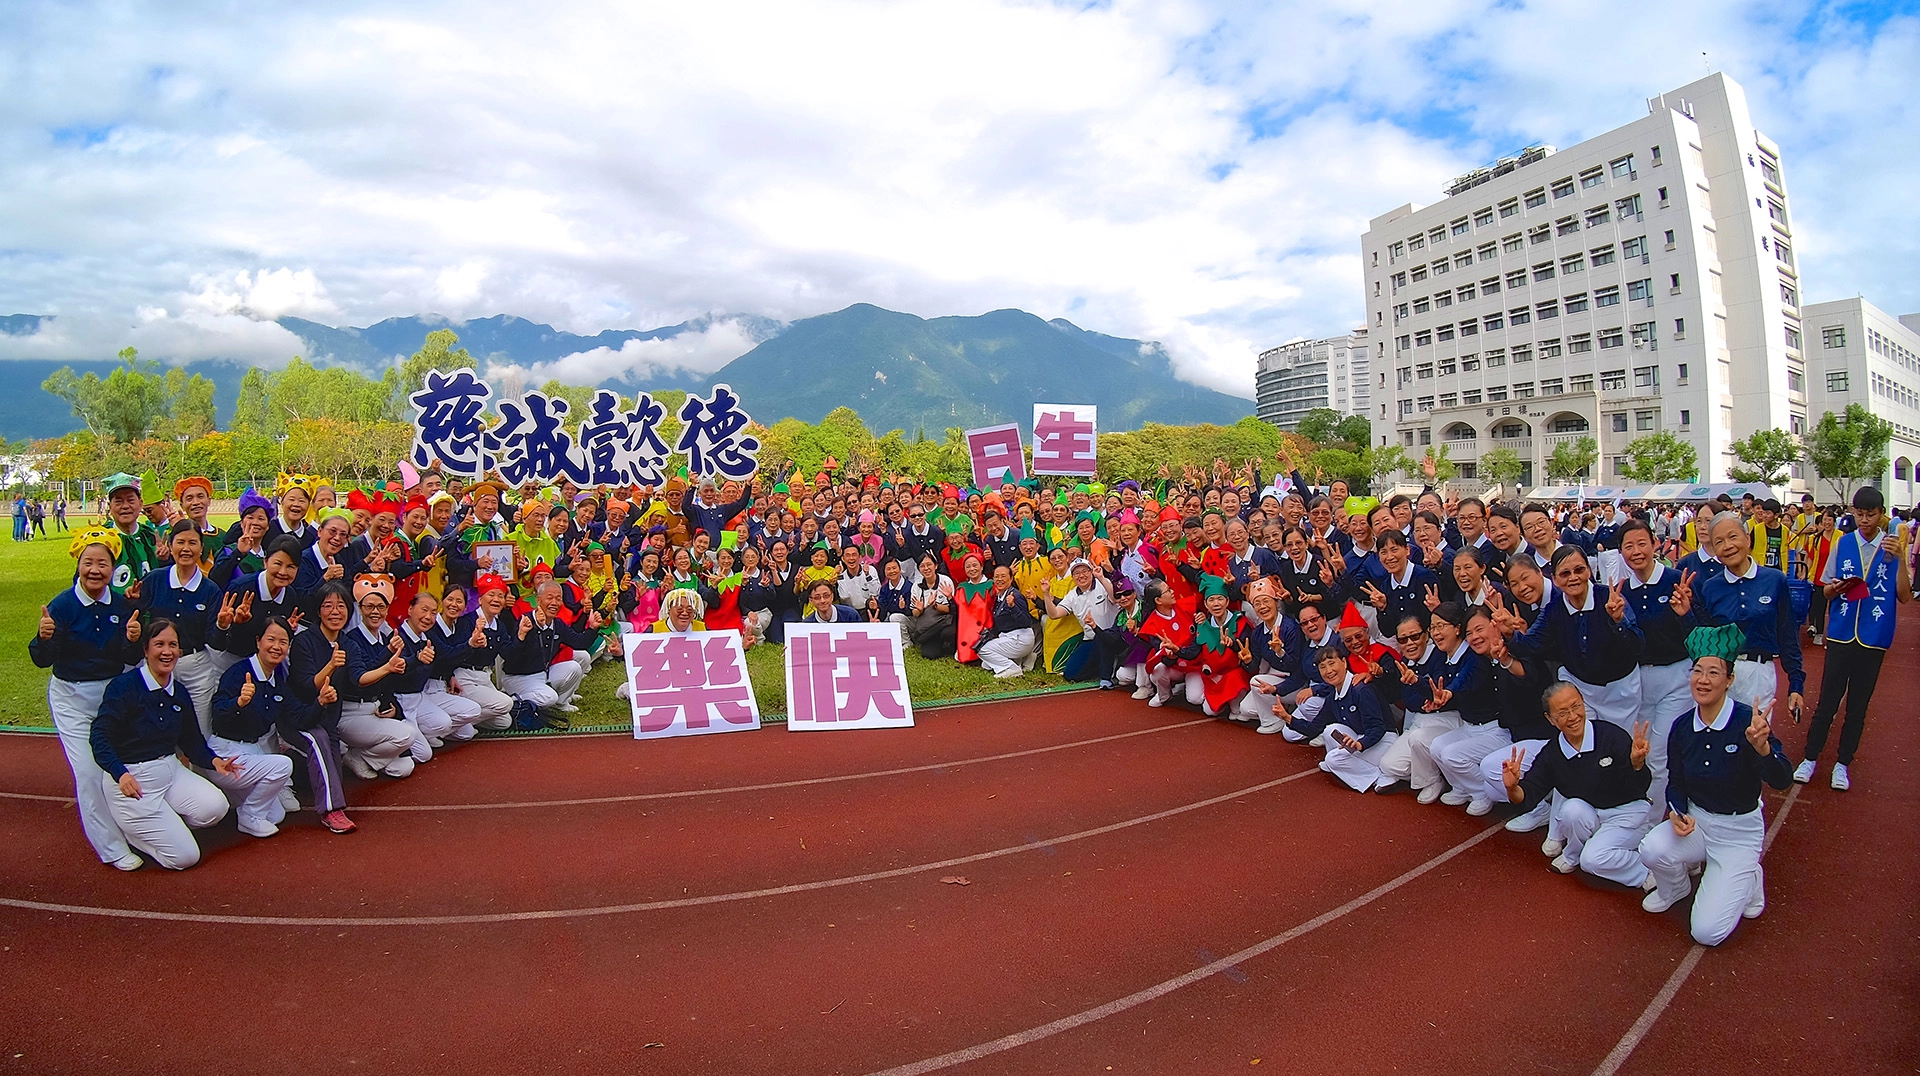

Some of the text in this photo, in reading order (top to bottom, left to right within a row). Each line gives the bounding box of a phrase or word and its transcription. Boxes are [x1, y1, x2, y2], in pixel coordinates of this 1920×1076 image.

[411, 371, 759, 488] 慈誠懿德
[968, 428, 1025, 491] 日
[1033, 411, 1096, 472] 生
[1872, 562, 1888, 622] 救人一命
[631, 636, 753, 733] 樂
[790, 631, 906, 723] 快
